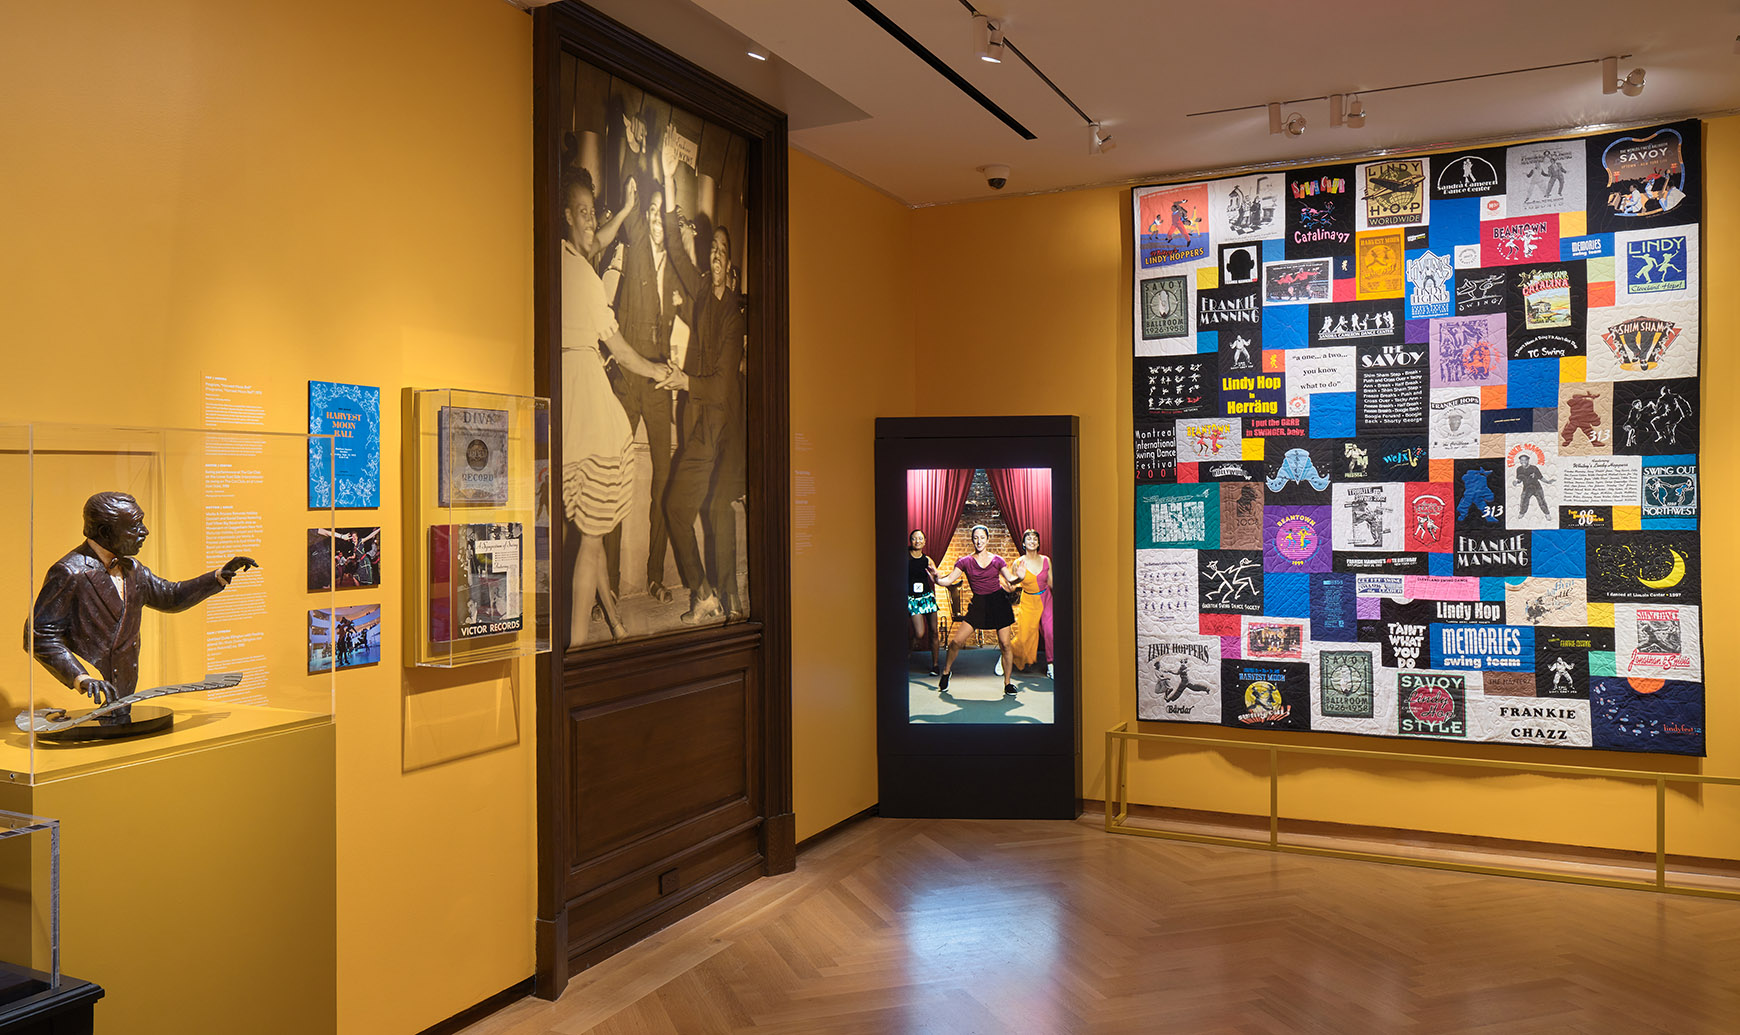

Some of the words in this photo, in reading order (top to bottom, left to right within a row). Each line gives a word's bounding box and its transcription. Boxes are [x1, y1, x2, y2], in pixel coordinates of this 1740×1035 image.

[1619, 147, 1668, 163] SAVOY
[1368, 163, 1420, 176] LINDY
[1437, 181, 1463, 191] Sandra
[1464, 180, 1498, 188] Cameron
[1443, 187, 1466, 195] Dance
[1467, 185, 1491, 193] Center
[1369, 215, 1420, 226] WORLDWIDE
[1494, 222, 1547, 239] BEANTOWN
[1571, 239, 1601, 252] MEMORIES
[1629, 237, 1685, 254] LINDY
[1144, 255, 1168, 265] LINDY
[1169, 247, 1204, 262] HOPPERS
[1145, 280, 1183, 291] SAVOY
[1522, 279, 1569, 296] CATALINA
[1631, 283, 1660, 293] Cleveland
[1200, 293, 1257, 311] FRANKIE
[1146, 319, 1184, 327] BALLROOM
[1200, 308, 1260, 325] MANNING
[1146, 325, 1184, 334] 1926-1958
[1619, 322, 1639, 335] SHIM
[1640, 321, 1664, 332] SHAM
[1382, 345, 1404, 354] THE
[1528, 349, 1539, 358] TC
[1542, 347, 1565, 356] Swing
[1361, 351, 1425, 368] SAVOY
[1303, 368, 1317, 376] you
[1222, 376, 1255, 392] Lindy
[1257, 375, 1281, 391] Hop
[1227, 399, 1278, 415] Herräng
[1431, 400, 1458, 410] FRANKIE
[326, 412, 362, 421] HARVEST
[463, 410, 496, 424] DIVA
[1256, 419, 1267, 428] put
[1268, 418, 1280, 427] the
[332, 421, 356, 429] MOON
[1187, 424, 1230, 437] BEANTOWN
[334, 430, 354, 438] BALL
[1135, 427, 1176, 440] Montreal
[1246, 429, 1253, 437] in
[1588, 429, 1610, 442] 313
[1135, 438, 1176, 451] International
[1136, 449, 1155, 460] Swing
[1156, 449, 1176, 458] Dance
[1136, 458, 1176, 470] Festival
[1643, 466, 1674, 475] SWING
[1676, 466, 1696, 474] OUT
[461, 473, 494, 482] RECORD
[1482, 505, 1504, 518] 313
[1642, 507, 1696, 516] NORTHWEST
[1277, 515, 1316, 527] BEANTOWN
[1458, 533, 1526, 551] FRANKIE
[1457, 551, 1528, 569] MANNING
[1436, 602, 1472, 621] Lindy
[1474, 602, 1501, 621] Hop
[461, 624, 488, 637] VICTOR
[489, 620, 520, 632] RECORDS
[1387, 622, 1427, 636] T'AINT
[1388, 635, 1424, 648] WHAT
[1442, 628, 1521, 656] MEMORIES
[1147, 643, 1171, 663] LINDY
[1172, 643, 1210, 663] HOPPERS
[1393, 647, 1420, 659] YOU
[1325, 655, 1368, 665] SAVOY
[1397, 658, 1416, 669] DO
[1443, 656, 1482, 668] swing
[1486, 656, 1521, 667] team
[1628, 648, 1662, 672] Jonathan
[1401, 675, 1464, 688] SAVOY
[1325, 697, 1368, 705] BALLROOM
[1404, 690, 1450, 708] Lindy
[1325, 703, 1368, 712] 1926-1958
[1420, 704, 1456, 719] Hop
[1500, 706, 1576, 720] FRANKIE
[1402, 719, 1462, 734] STYLE
[1511, 728, 1567, 740] CHAZZ
